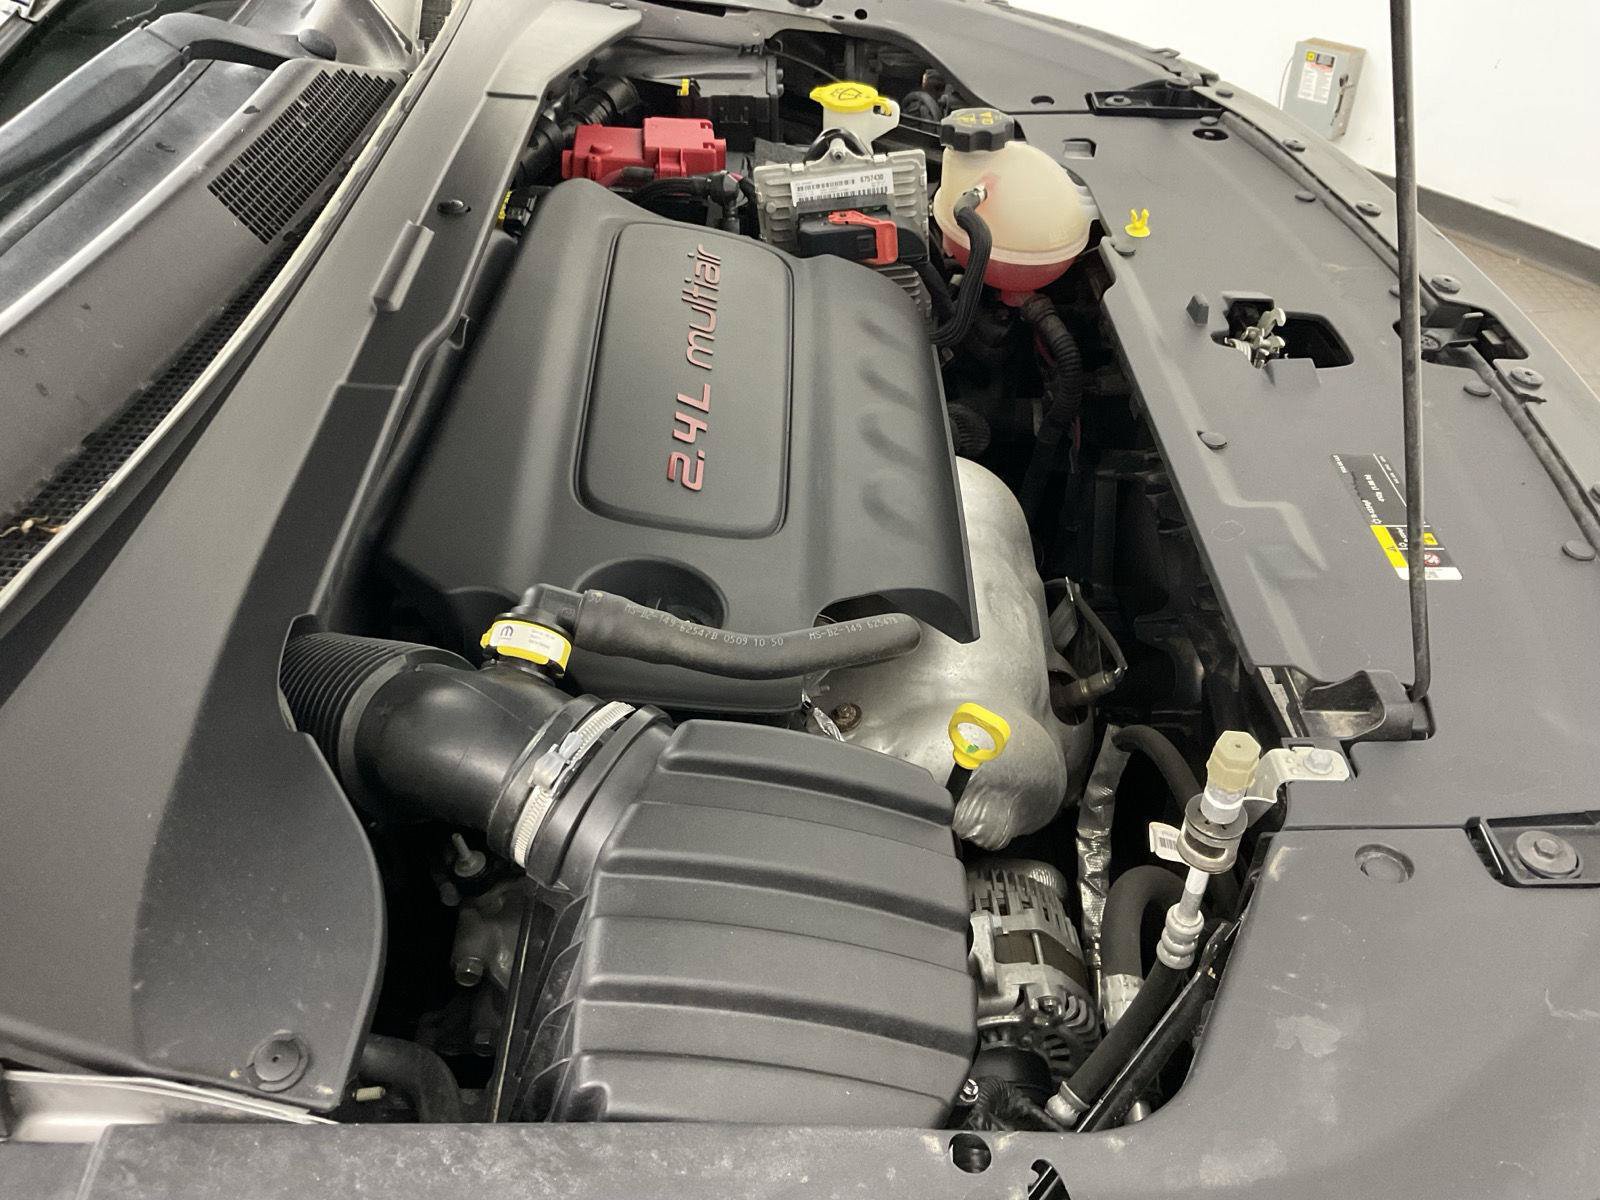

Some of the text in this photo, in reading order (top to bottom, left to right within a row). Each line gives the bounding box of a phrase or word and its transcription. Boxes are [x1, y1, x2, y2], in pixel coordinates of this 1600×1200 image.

[667, 243, 721, 491] 2.4L multiair
[723, 635, 748, 646] 0509
[753, 638, 766, 647] 10
[771, 637, 784, 647] 50
